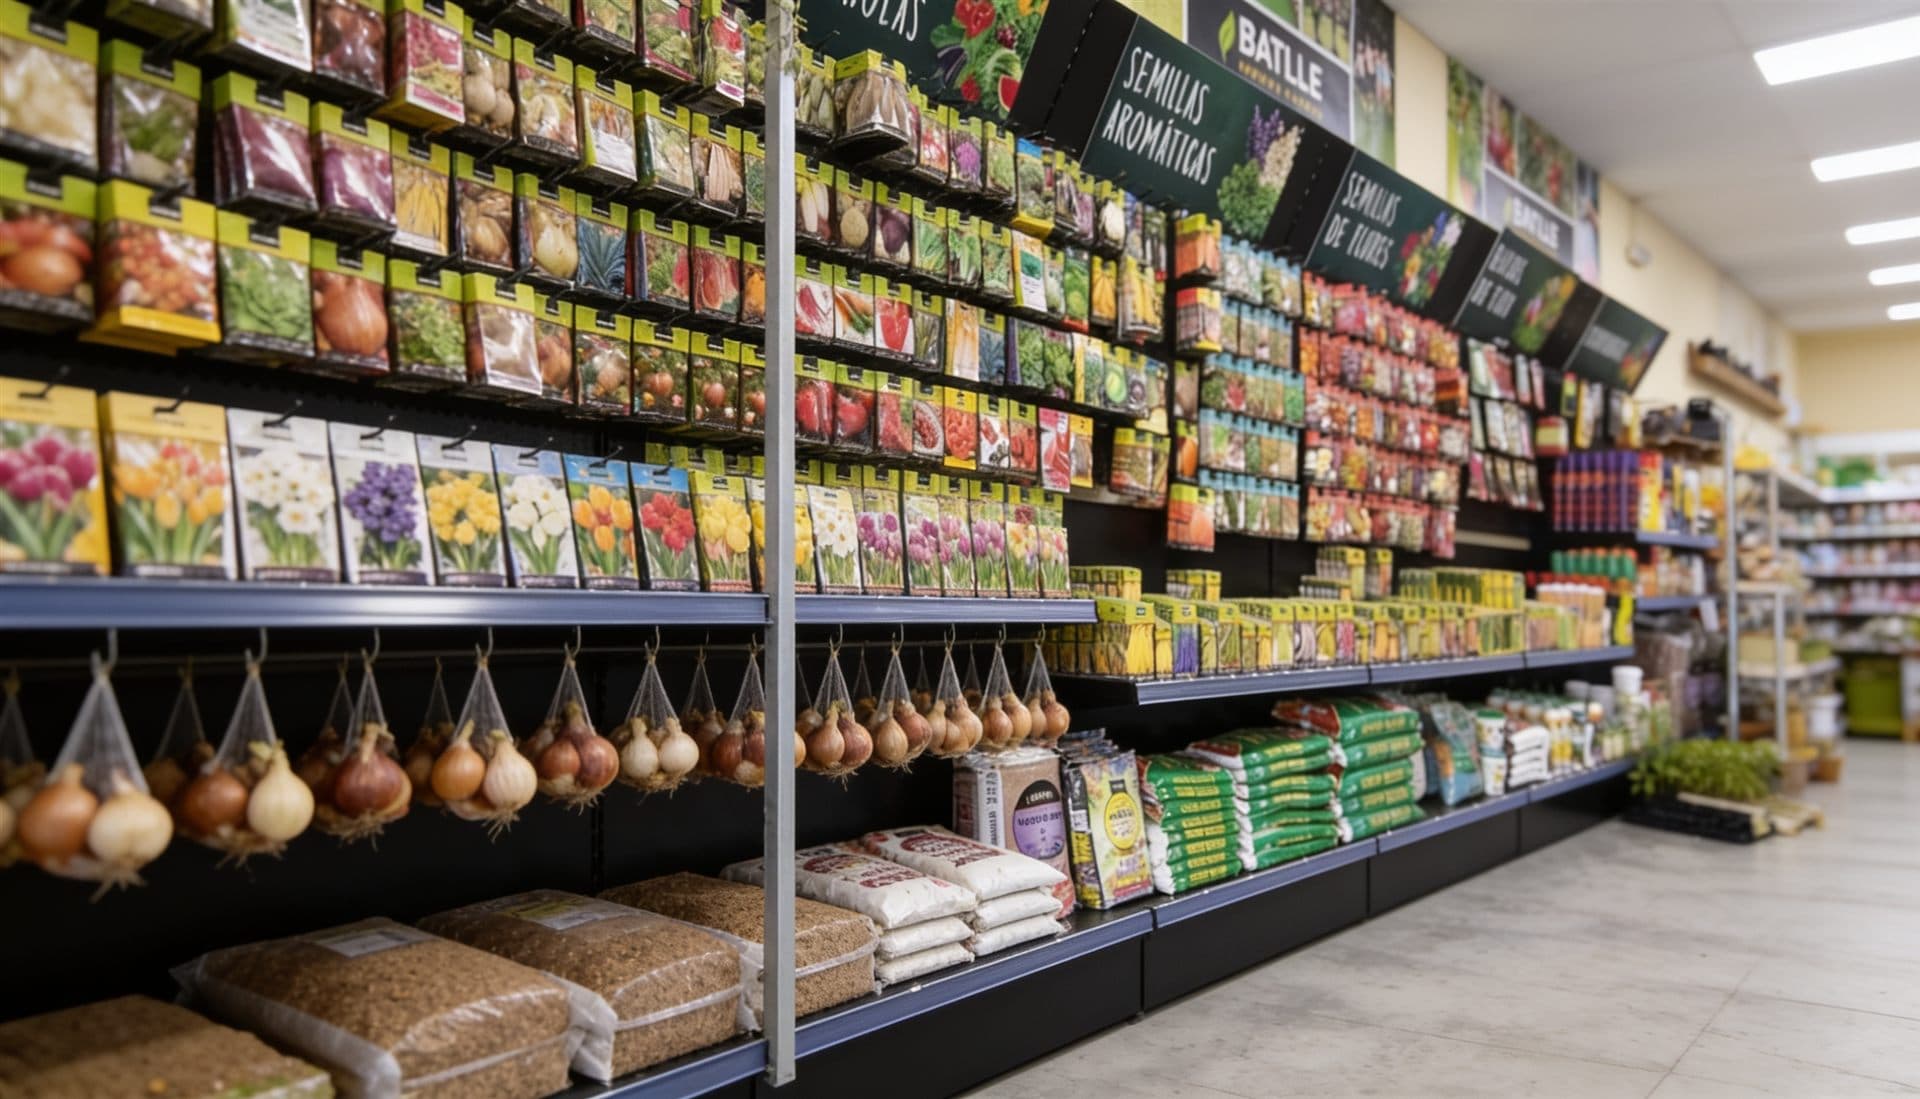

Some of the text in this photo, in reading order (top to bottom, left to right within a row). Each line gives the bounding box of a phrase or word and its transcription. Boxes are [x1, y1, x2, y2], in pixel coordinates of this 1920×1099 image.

[1123, 47, 1209, 125] SEMILLAS
[1239, 15, 1323, 101] BATLLE
[1102, 99, 1216, 185] AROMÁTICAS
[1342, 171, 1402, 228] SEMILLAS
[1323, 213, 1394, 269] DE FLORES
